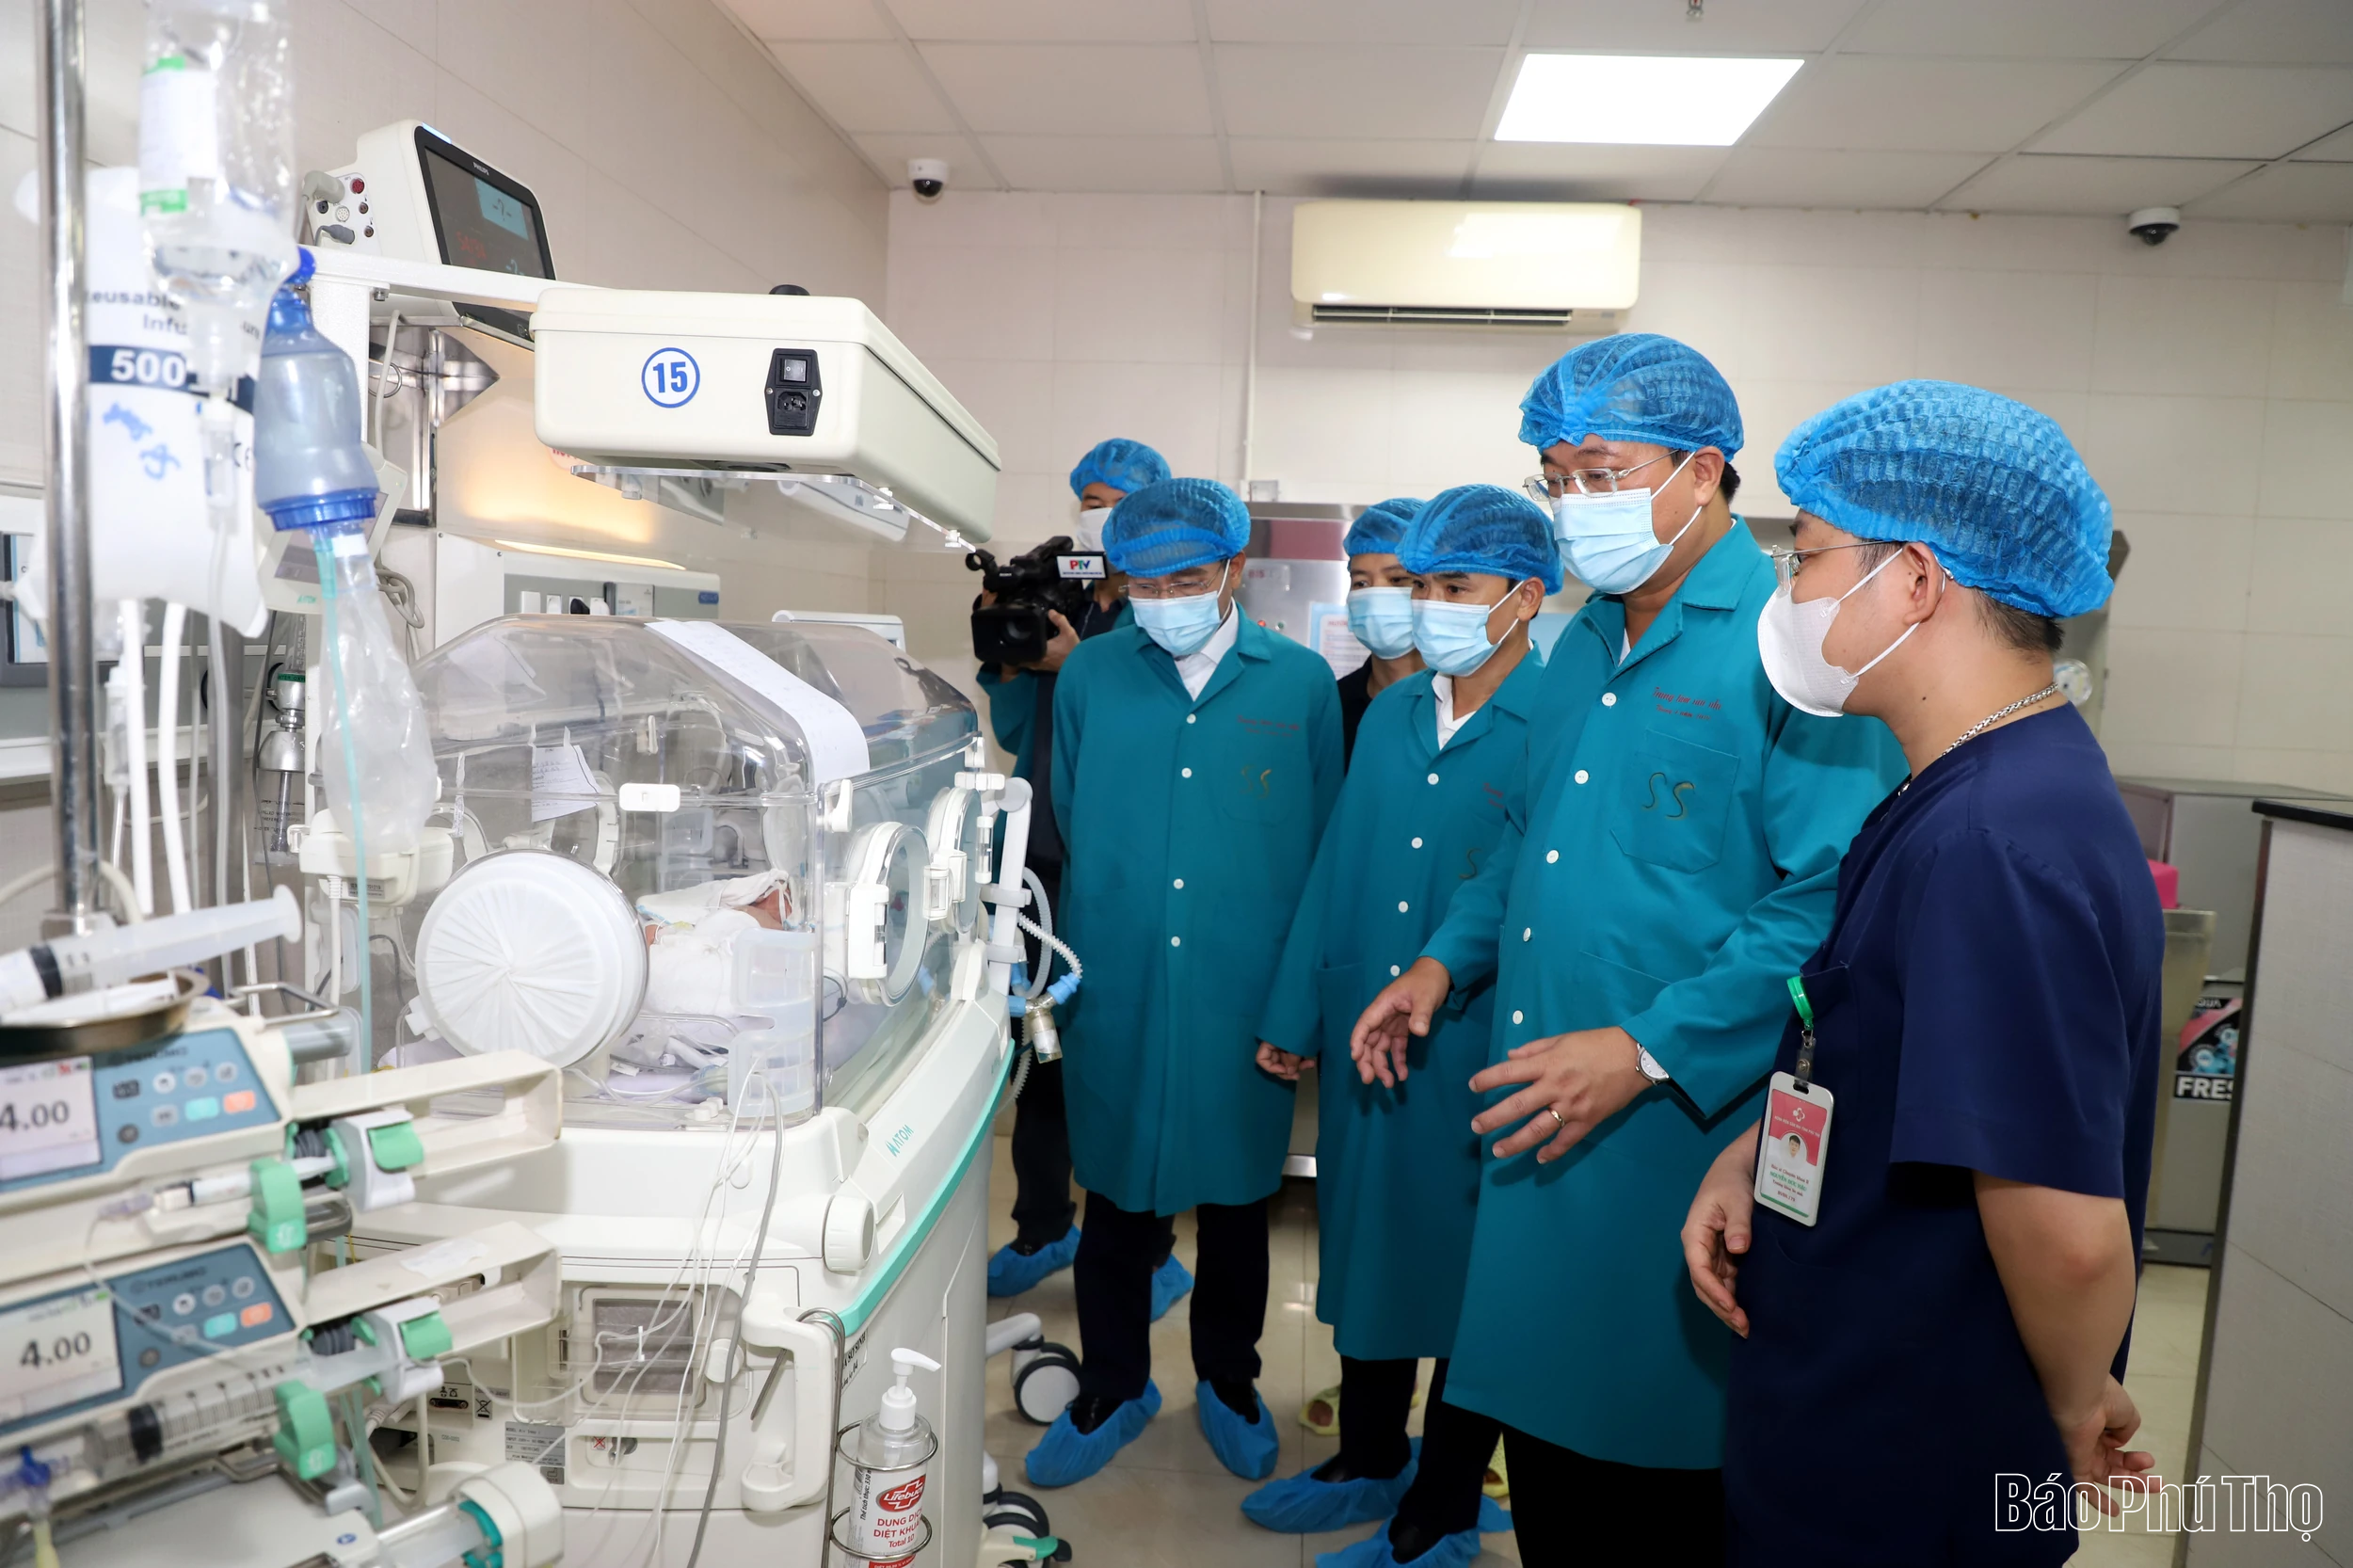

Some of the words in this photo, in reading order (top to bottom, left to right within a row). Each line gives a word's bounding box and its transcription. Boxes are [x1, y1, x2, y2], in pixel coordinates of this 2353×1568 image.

[85, 288, 181, 311] eusable
[110, 349, 187, 389] 500
[652, 361, 688, 393] 15
[1069, 559, 1091, 570] PTV
[19, 1331, 92, 1368] 4.00
[877, 1517, 905, 1527] DUNG
[873, 1529, 897, 1539] DIỆT
[888, 1538, 905, 1548] Total
